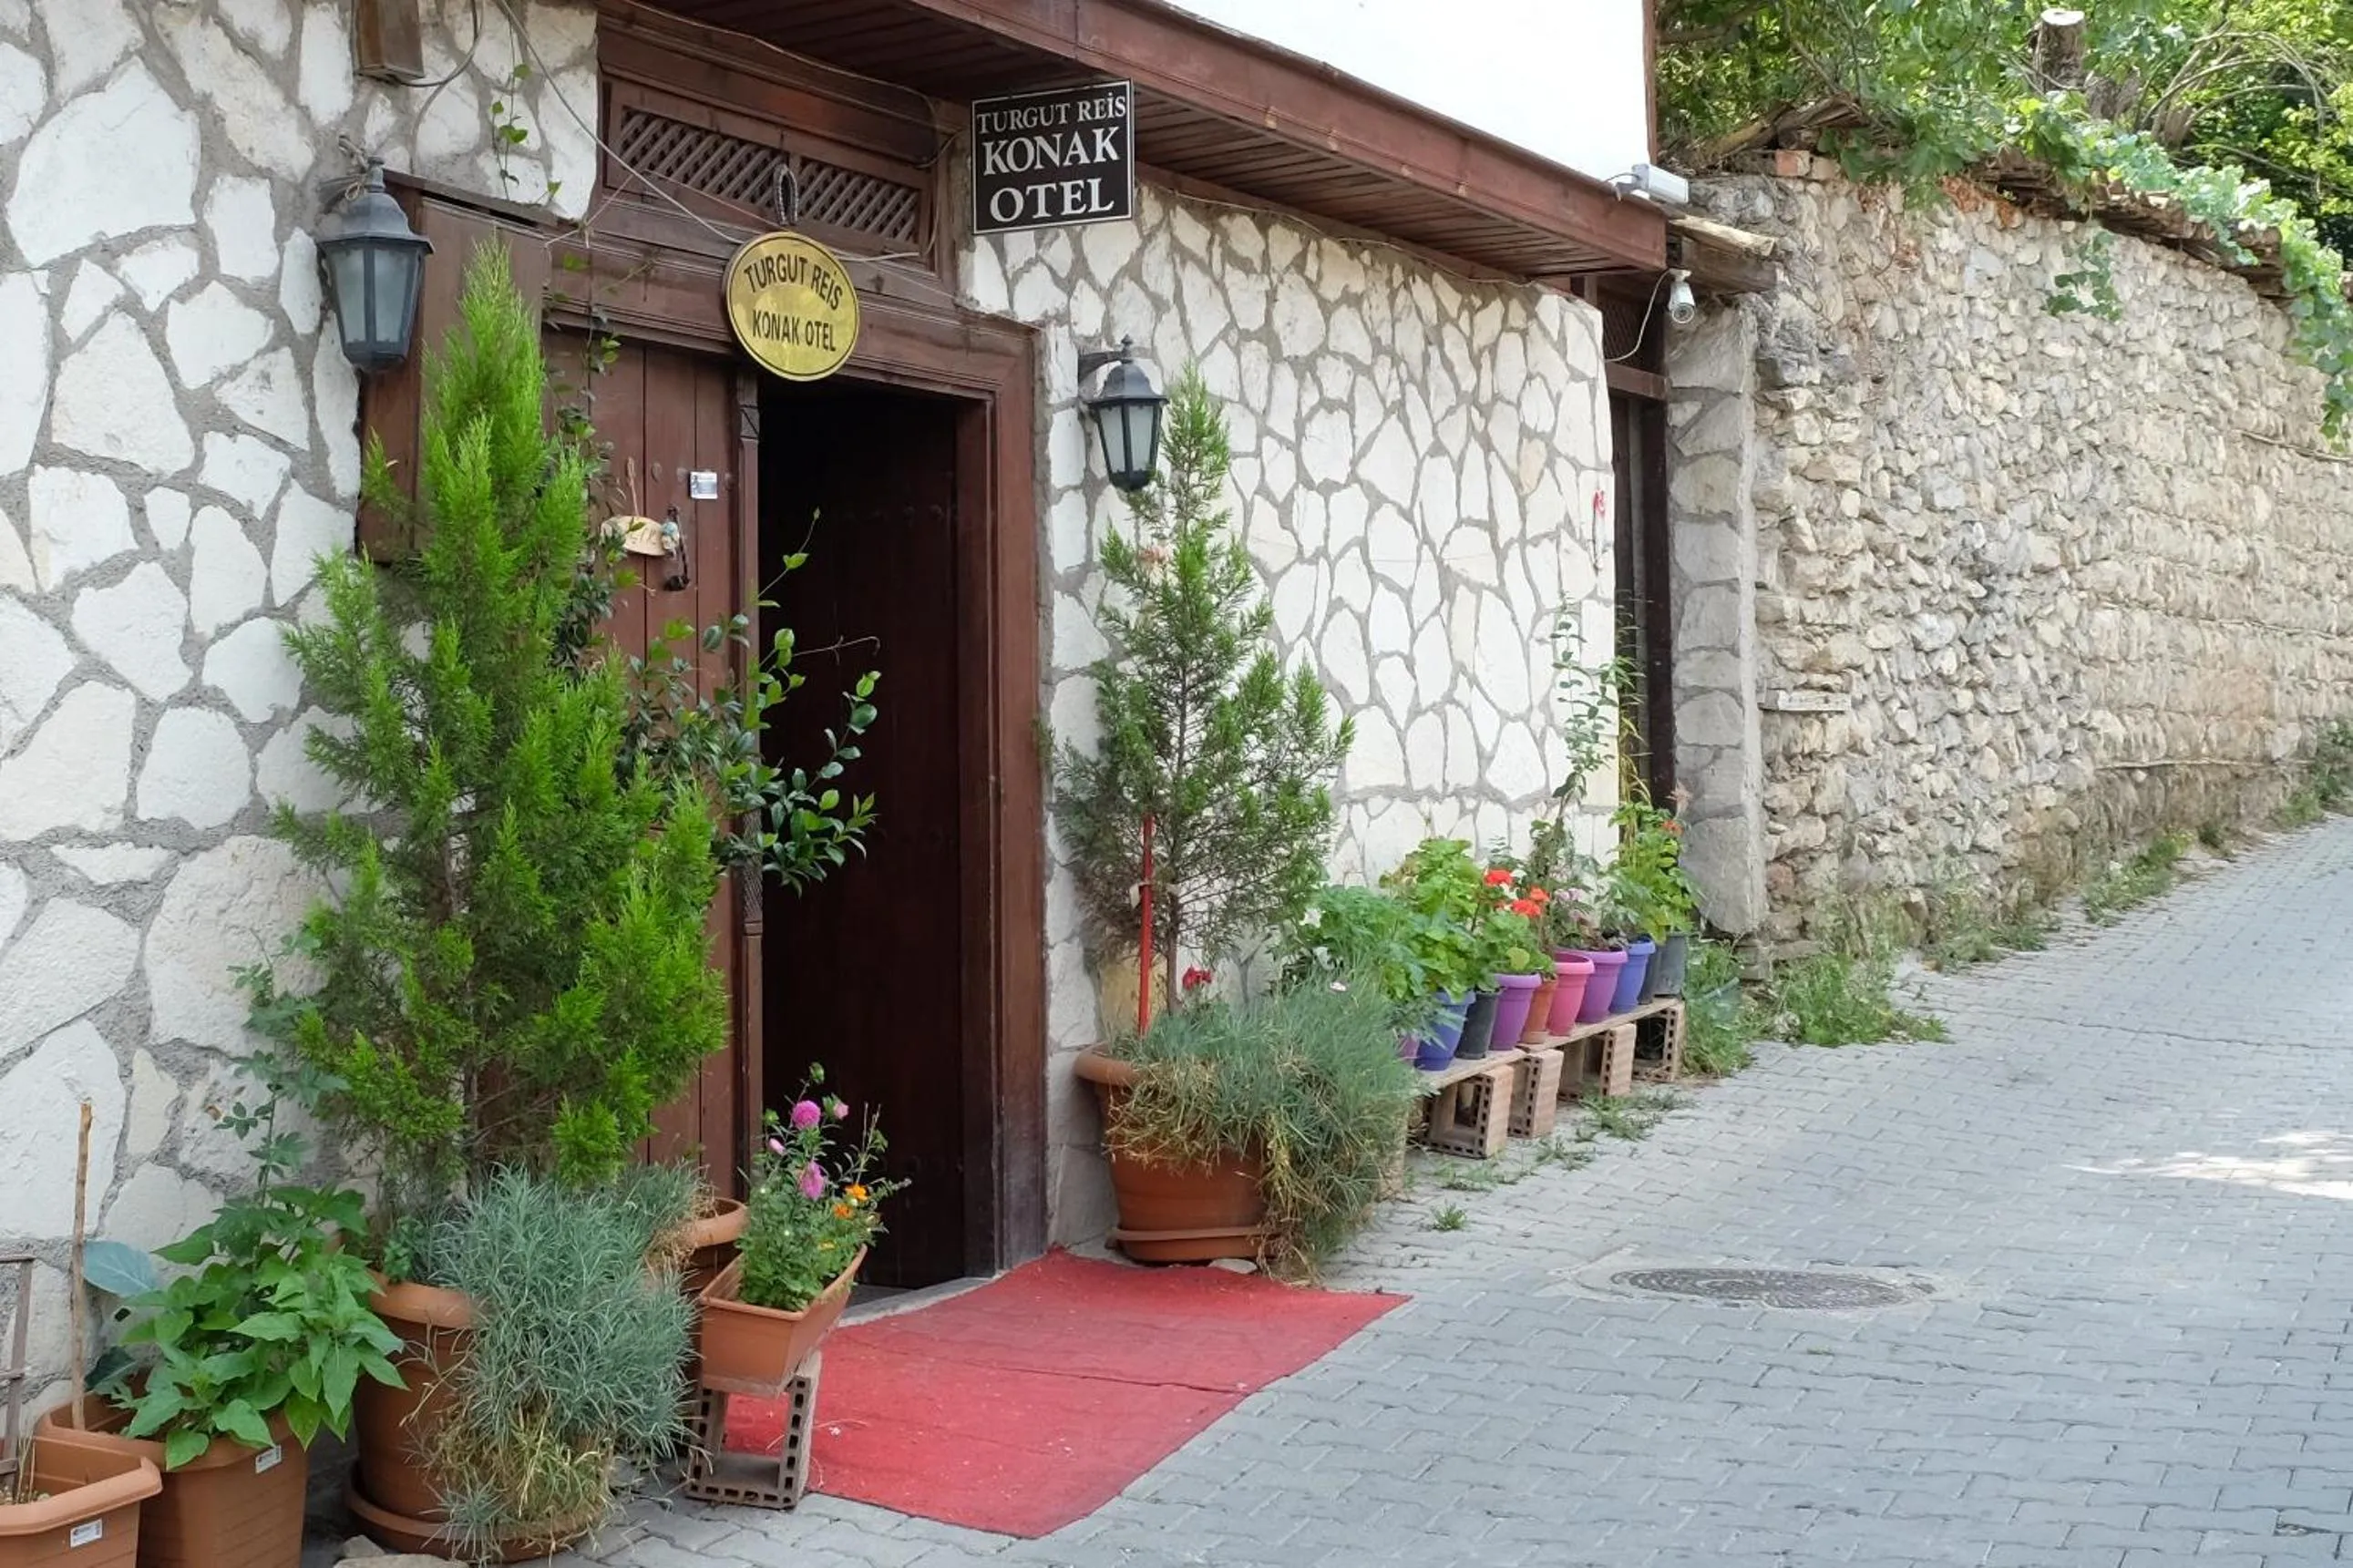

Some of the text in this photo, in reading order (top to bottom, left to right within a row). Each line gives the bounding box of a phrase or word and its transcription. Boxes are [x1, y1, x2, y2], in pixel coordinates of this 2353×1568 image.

[976, 102, 1071, 134] TURGUT
[981, 126, 1120, 176] KONAK
[990, 177, 1115, 222] OTEL
[744, 253, 808, 292] TURGUT
[752, 309, 837, 352] KONAK OTEL
